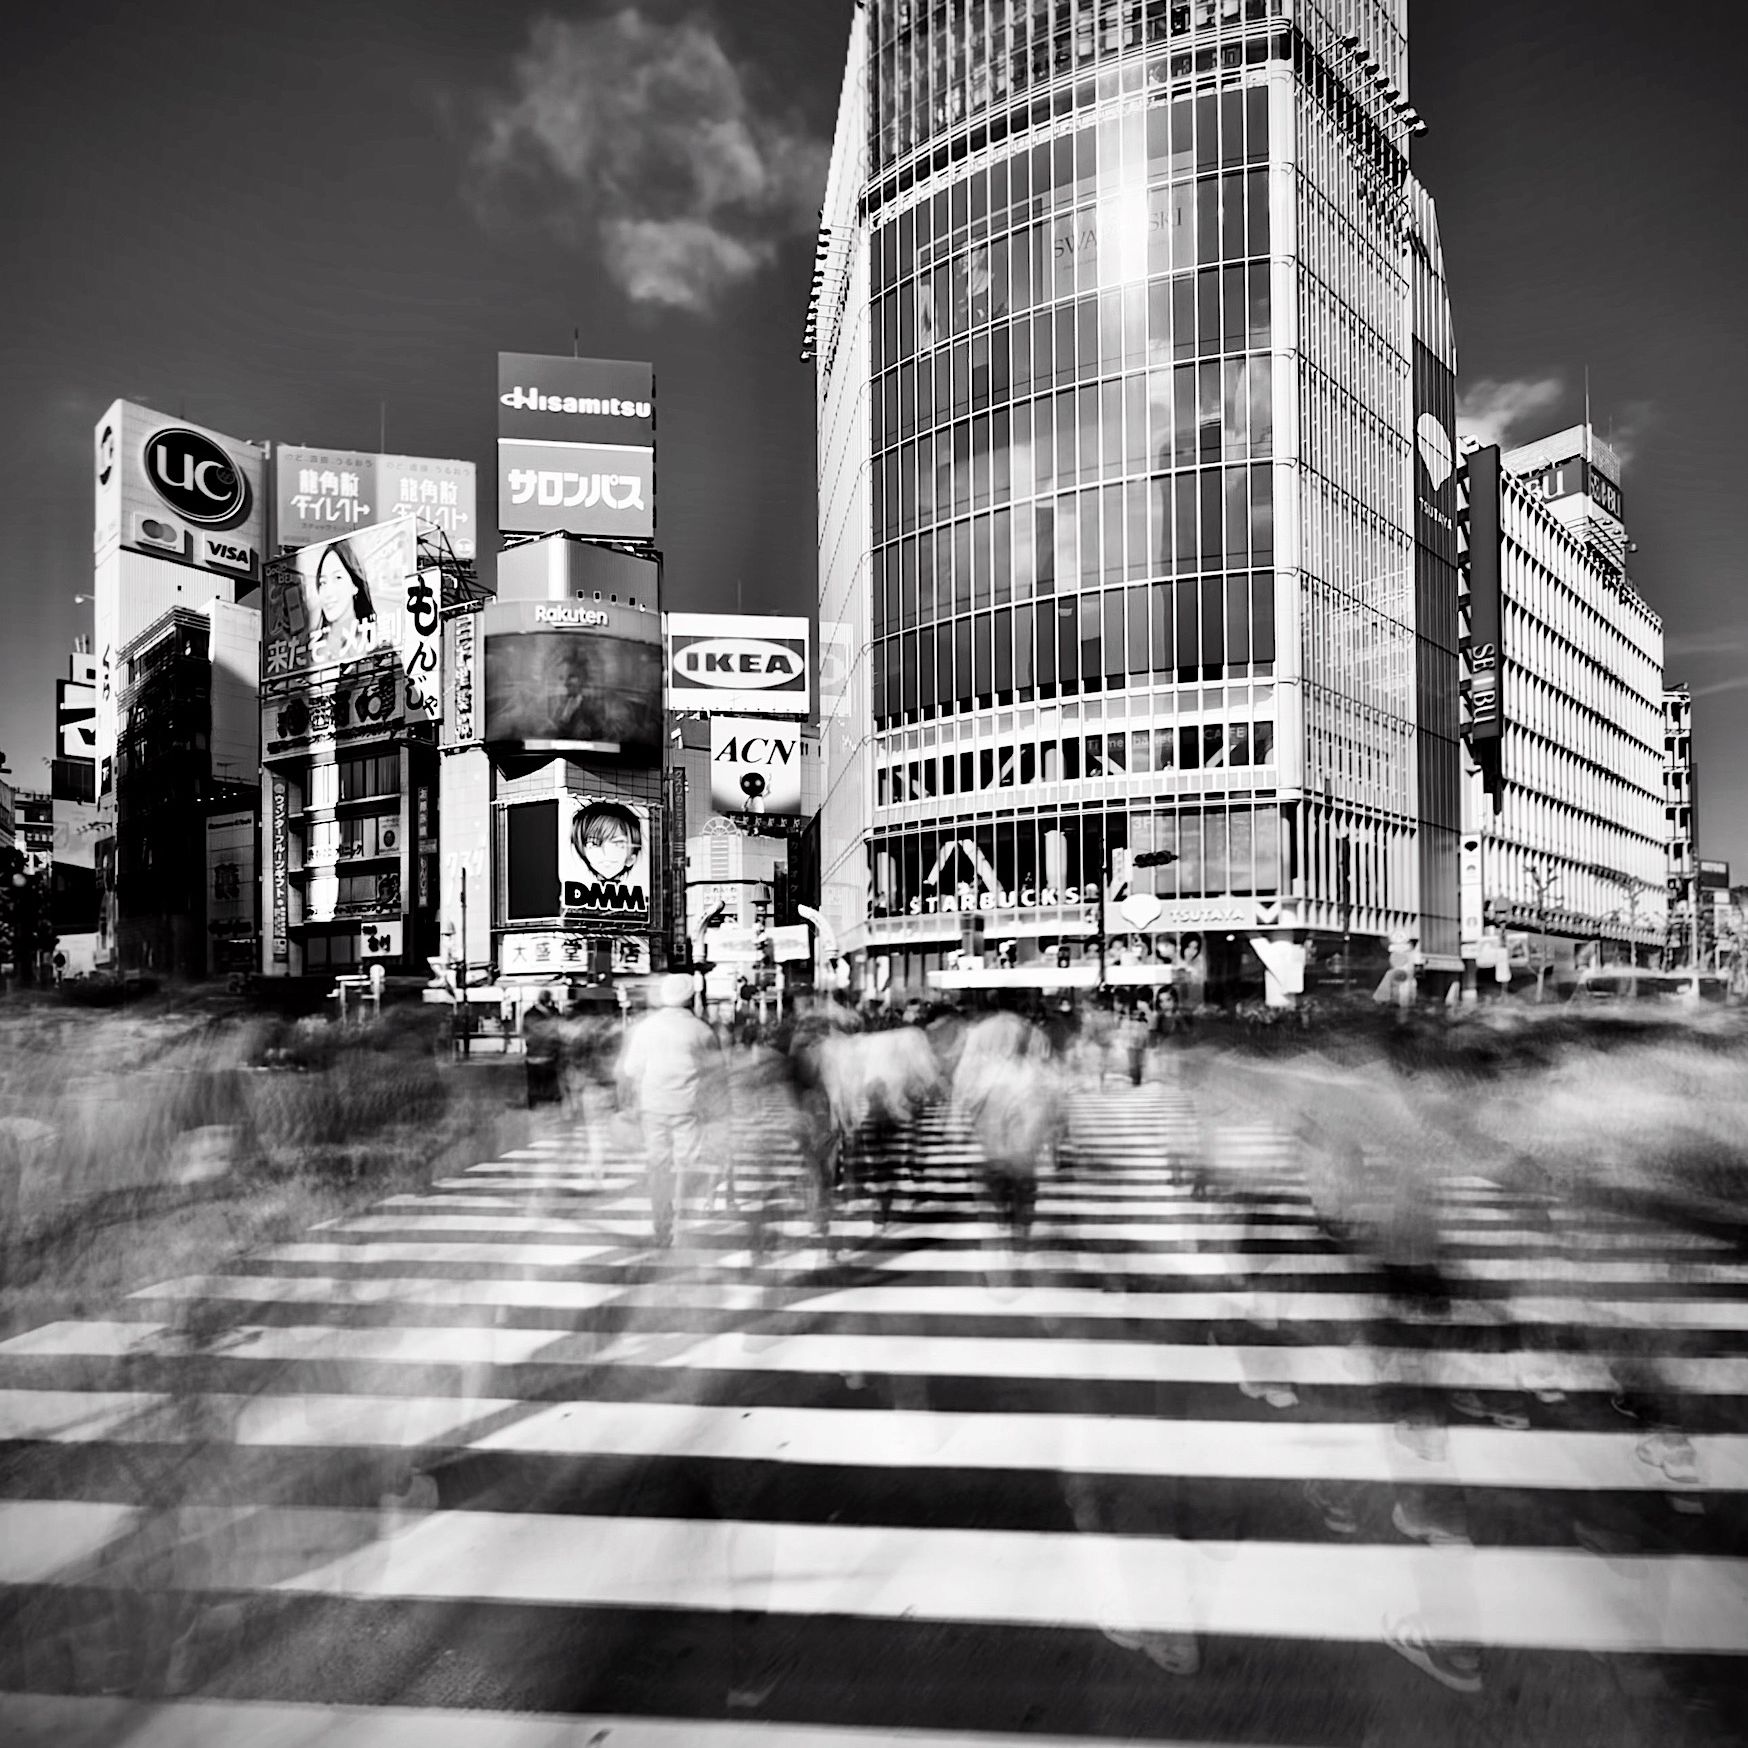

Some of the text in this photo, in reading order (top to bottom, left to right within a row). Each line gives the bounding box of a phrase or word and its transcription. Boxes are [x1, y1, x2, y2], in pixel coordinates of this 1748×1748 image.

[500, 386, 651, 418] Hisamitsu
[156, 444, 232, 501] UC
[299, 469, 359, 497] 龍角散
[508, 468, 645, 511] サロンパス
[1418, 496, 1452, 530] TSUTAYA
[207, 540, 249, 564] VISA
[535, 605, 608, 626] Rakuten
[405, 574, 438, 716] もんじゃ
[686, 652, 794, 675] IKEA
[1472, 643, 1496, 724] SEIBU
[715, 736, 798, 765] ACN
[564, 881, 647, 910] DMM
[910, 886, 1080, 915] STARBUCKS
[1169, 908, 1245, 924] TSUTAYA
